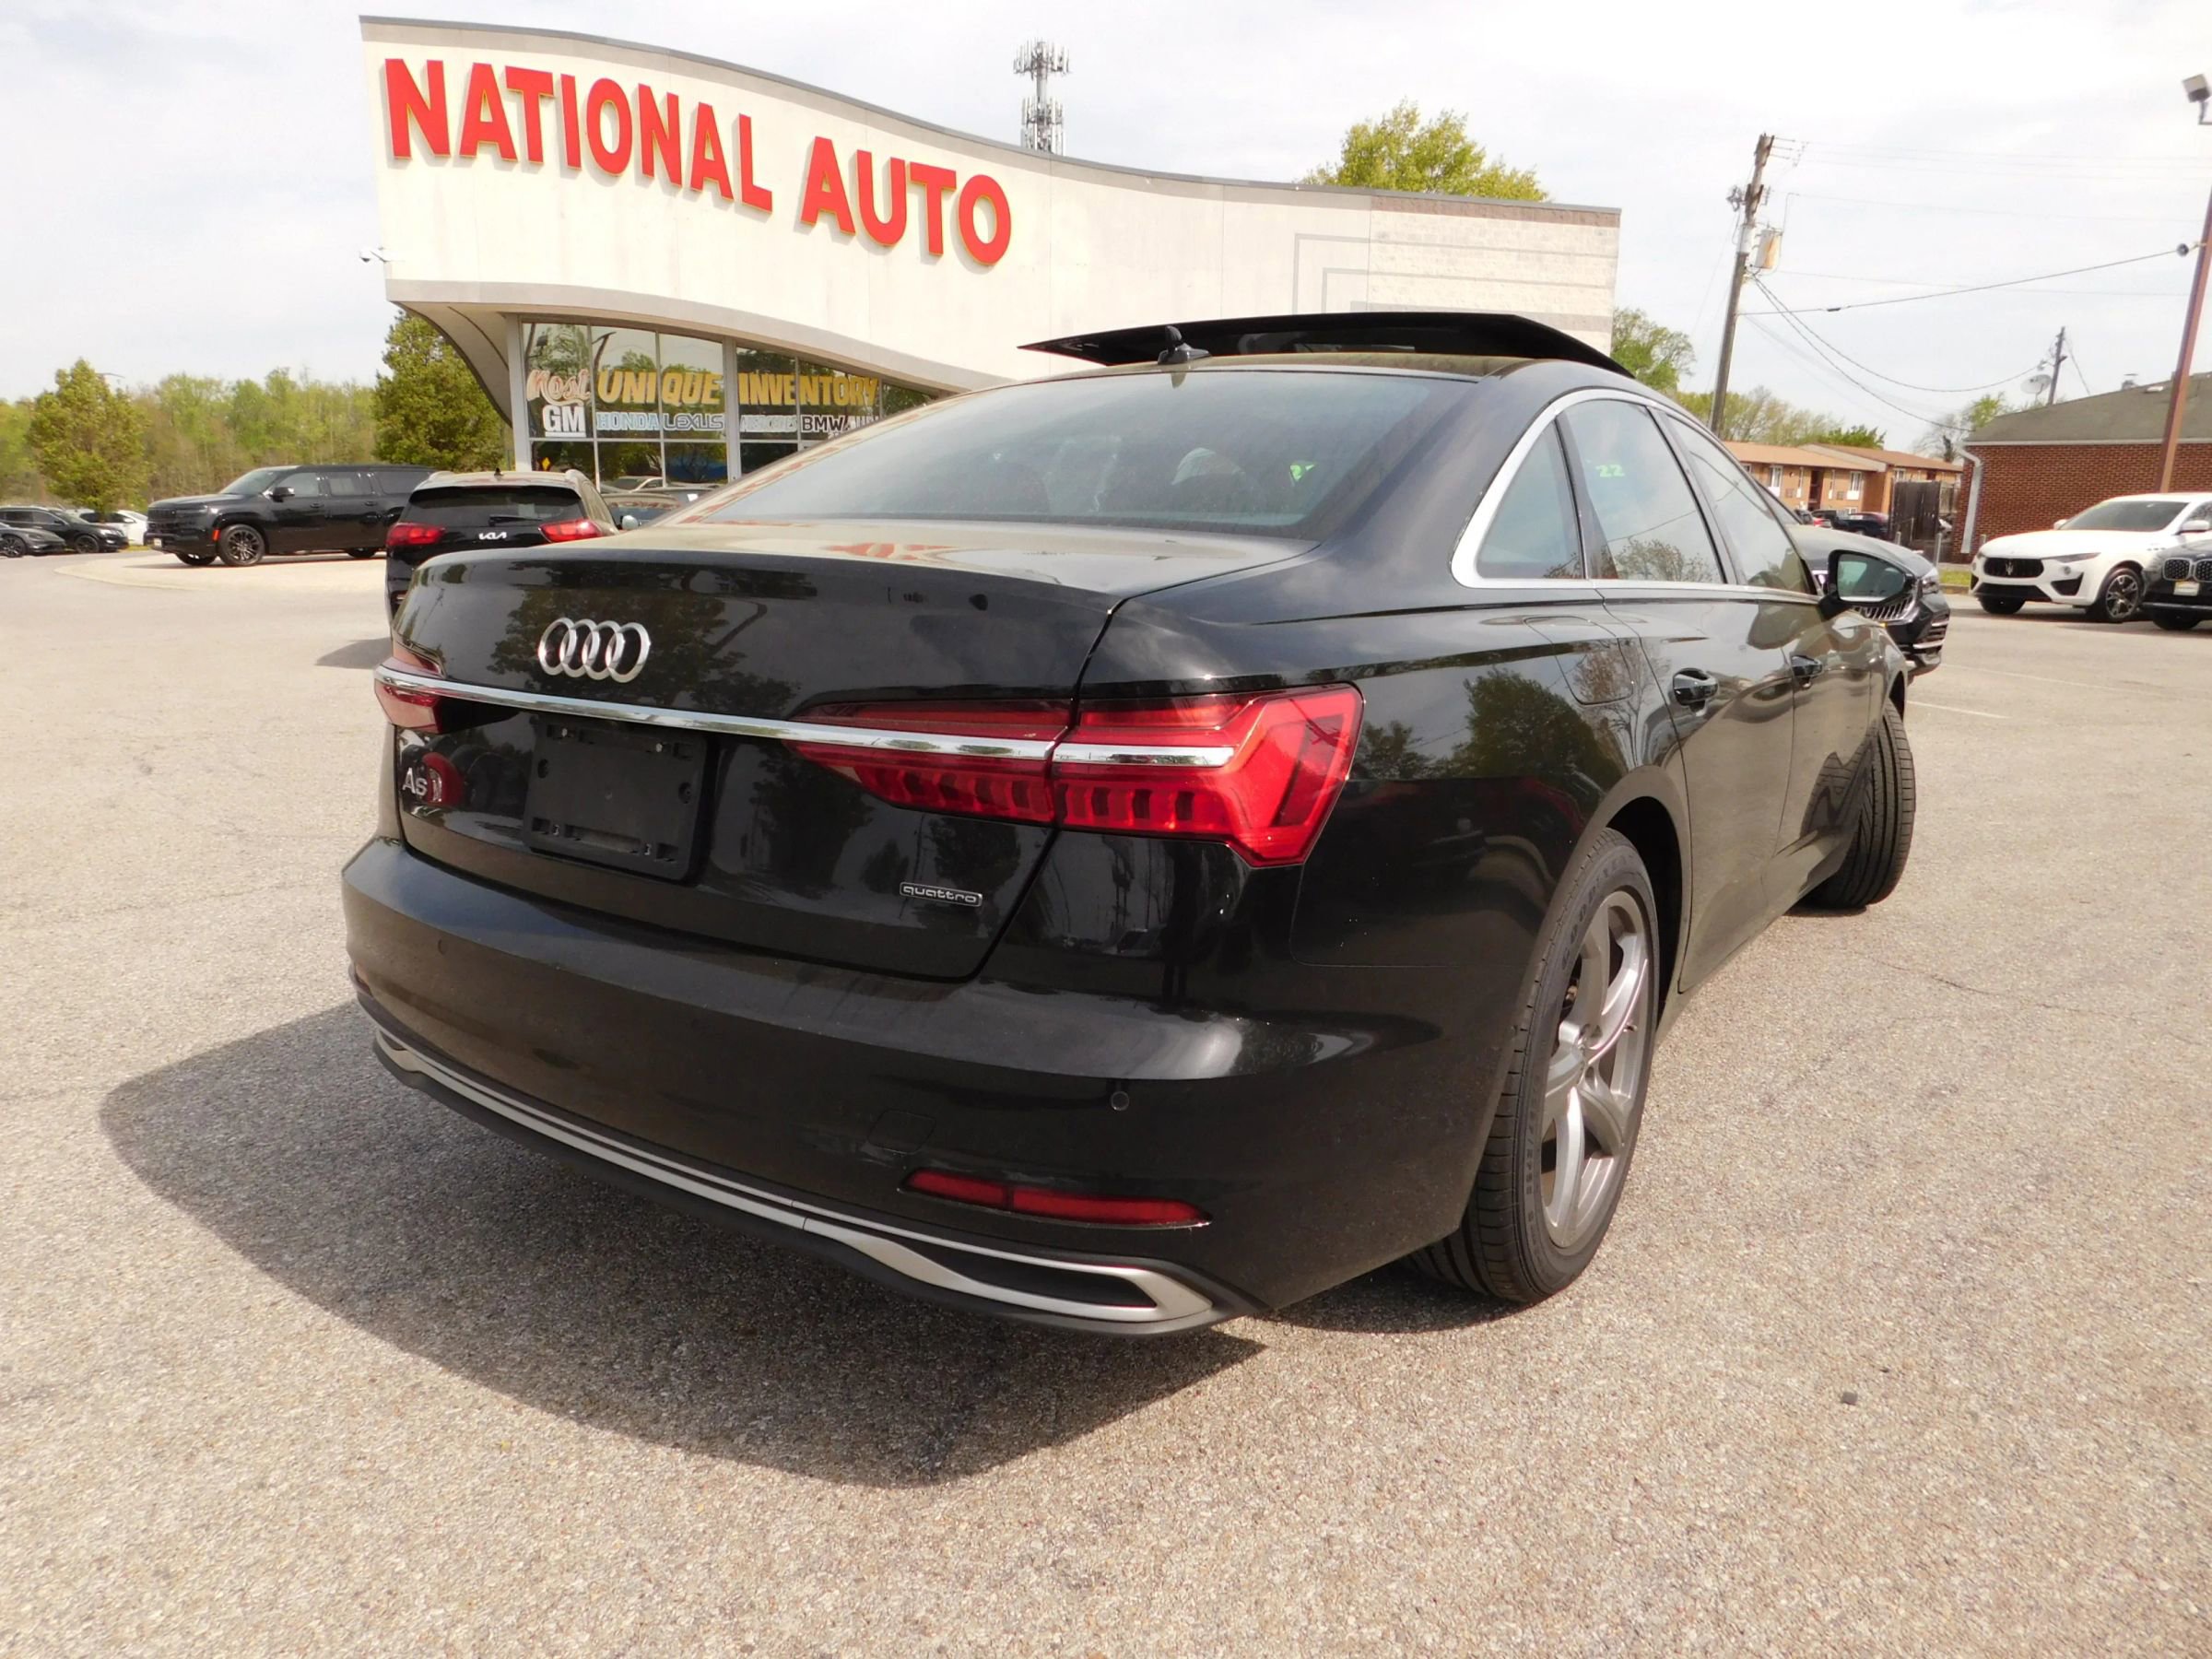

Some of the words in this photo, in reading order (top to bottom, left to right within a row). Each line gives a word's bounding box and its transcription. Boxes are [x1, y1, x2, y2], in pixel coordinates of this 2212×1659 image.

[383, 57, 773, 214] NATIONAL
[799, 135, 1012, 265] AUTO
[597, 371, 724, 406] UNIQUE
[738, 371, 879, 406] INVENTORY
[542, 405, 586, 432] GM
[596, 411, 660, 431] HONDA
[663, 412, 724, 431] LEXUS
[801, 414, 846, 433] BMW
[902, 885, 977, 904] quattro
